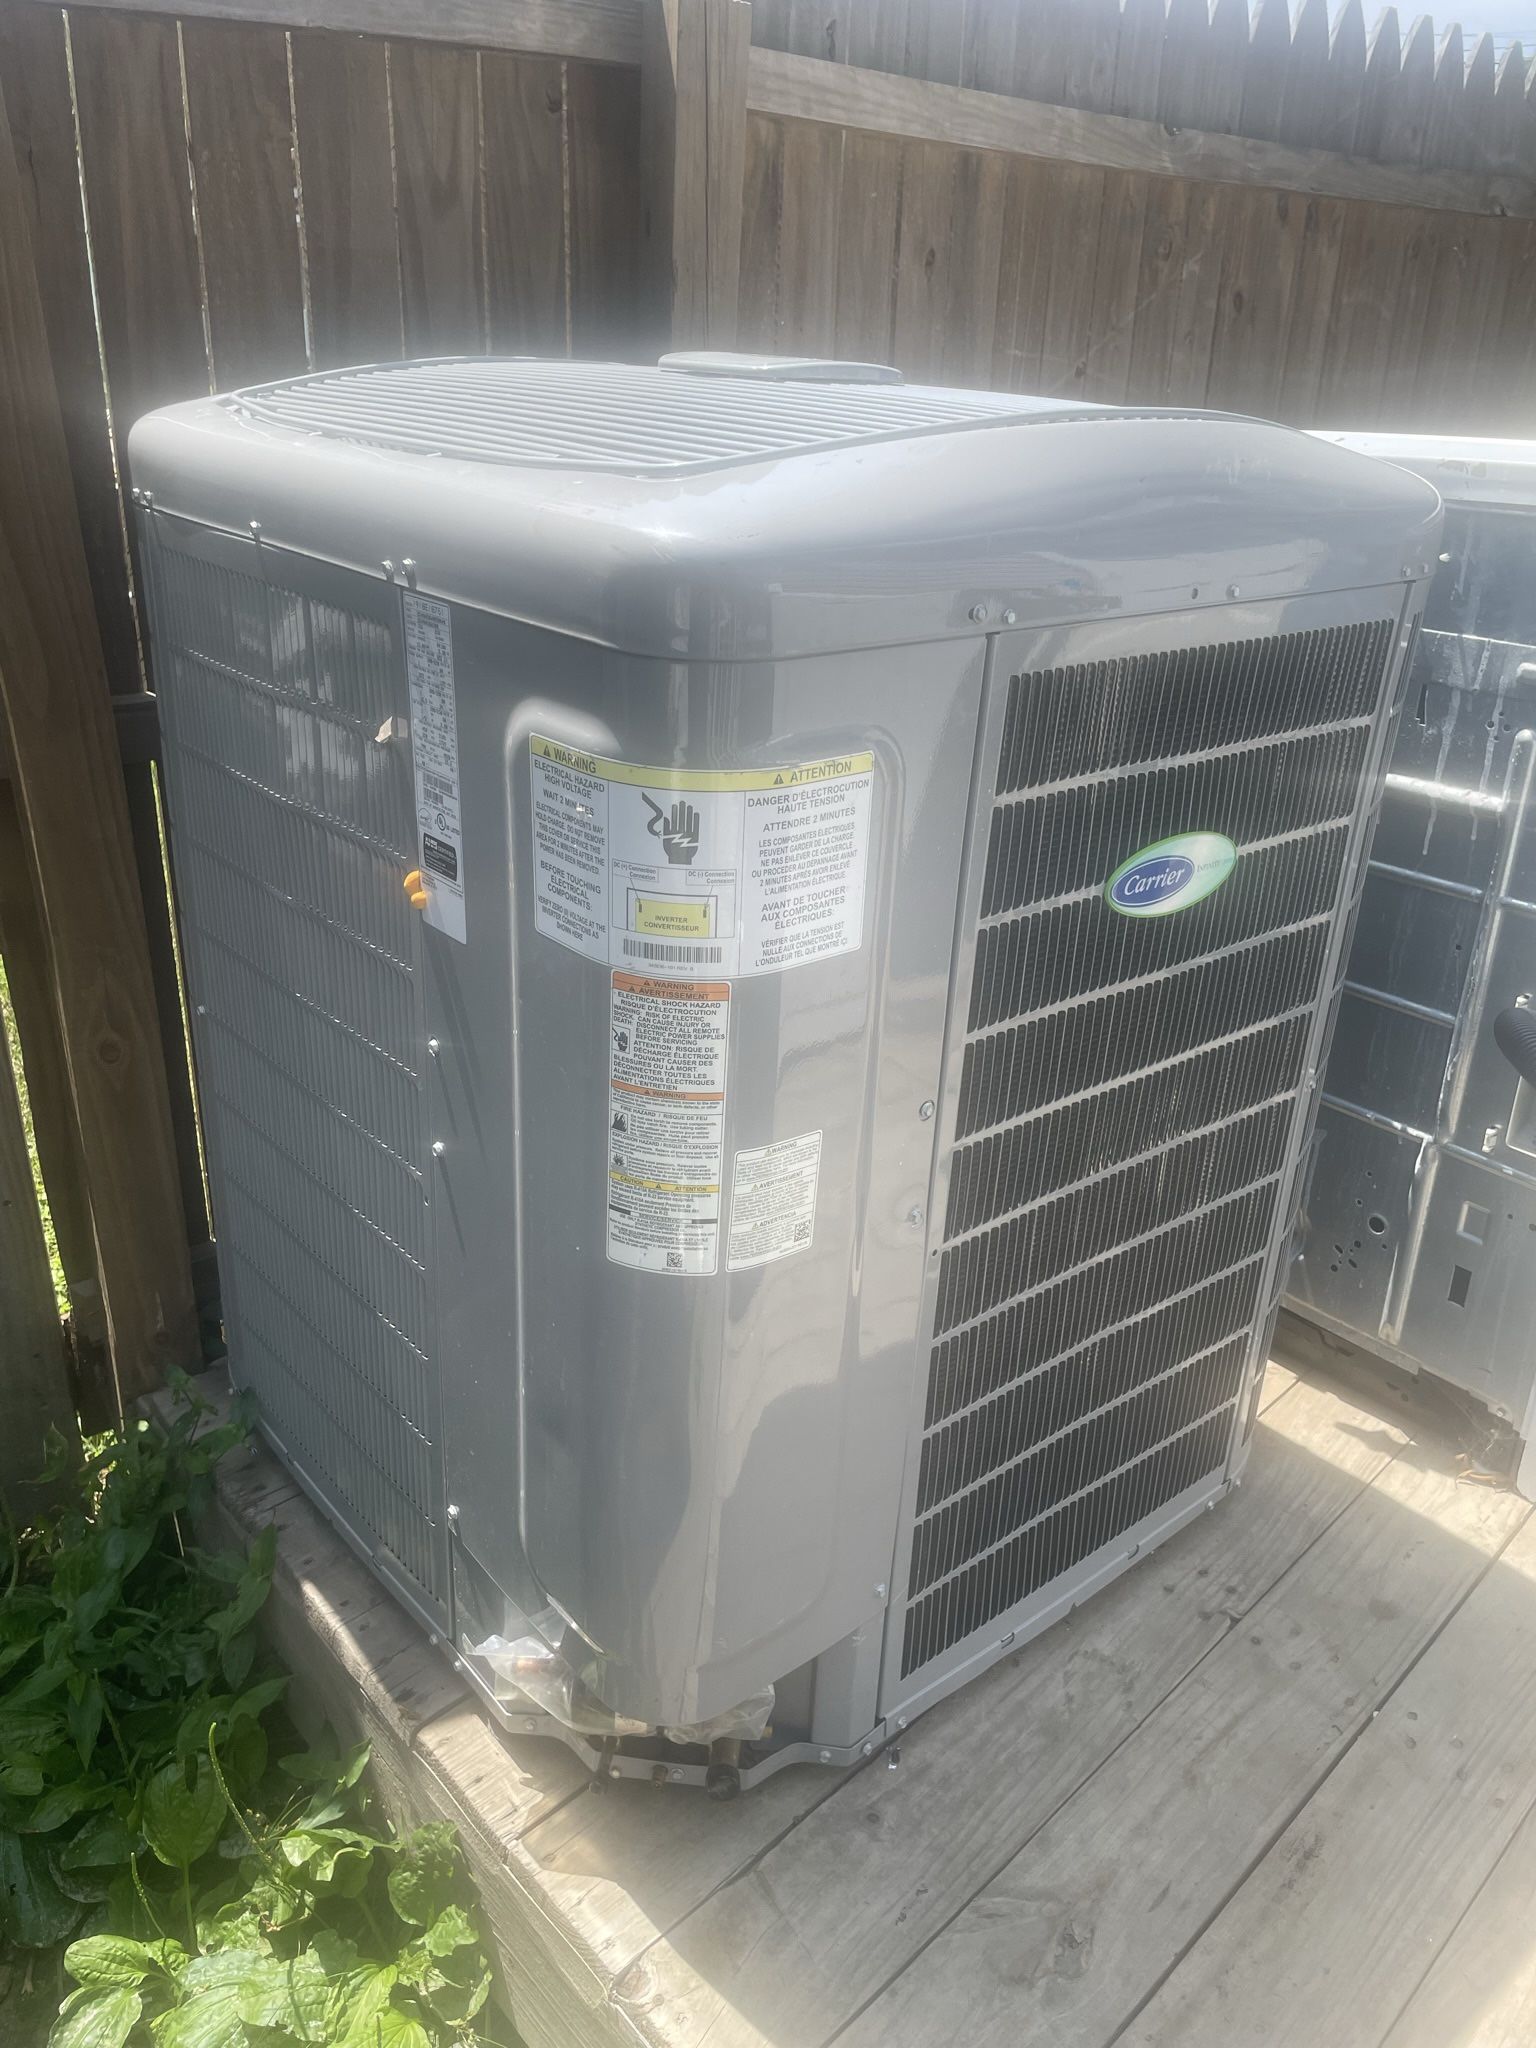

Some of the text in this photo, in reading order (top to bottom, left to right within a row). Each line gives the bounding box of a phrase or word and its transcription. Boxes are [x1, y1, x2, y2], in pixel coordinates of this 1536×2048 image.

[554, 748, 596, 773] WARNING
[535, 760, 604, 792] ELECTRICAL HAZARD
[791, 761, 852, 783] ATTENTION
[545, 774, 591, 799] HIGH VOLTAGE
[748, 779, 869, 807] DANGER D'ÉLECTROCUTION
[543, 788, 558, 800] WAIT
[560, 796, 563, 804] 2
[778, 794, 845, 814] HAUTE TENSION
[763, 807, 855, 832] ATTENDRE 2 MINUTES
[759, 839, 771, 847] LES
[773, 831, 816, 846] COMPOSANTES
[760, 847, 788, 857] PEUVENT
[790, 841, 812, 853] GARDER
[823, 838, 830, 847] LA
[752, 870, 761, 878] OU
[798, 862, 806, 870] AU
[840, 850, 858, 859] AVANT
[761, 859, 770, 867] NE
[771, 857, 783, 866] PAS
[812, 849, 819, 857] CE
[541, 860, 601, 894] BEFORE TOUCHING
[760, 879, 763, 887] 2
[765, 875, 791, 885] MINUTES
[1124, 868, 1185, 895] Carrier
[551, 875, 589, 900] ELECTRICAL
[761, 896, 845, 922] AUX COMPOSANTES
[762, 900, 790, 911] AVANT
[794, 896, 804, 905] DE
[644, 922, 699, 931] CONVERTISSEUR
[655, 915, 688, 923] INVERTER
[789, 933, 800, 941] QUE
[802, 931, 809, 939] LA
[834, 921, 844, 930] EST
[762, 946, 782, 957] NULLE
[794, 949, 804, 957] TEL
[654, 980, 694, 991] WARNING
[618, 992, 659, 1005] ELECTRICAL
[639, 988, 710, 999] AVERTISSEMENT
[621, 1000, 645, 1010] RISQUE
[636, 1028, 666, 1038] ELECTRIC
[637, 1022, 677, 1032] DISCONNECT
[636, 1034, 660, 1042] BEFORE
[614, 1054, 652, 1068] BLESSURES
[634, 1053, 665, 1063] POUVANT
[614, 1068, 664, 1083] ALIMENTATIONS
[664, 1070, 691, 1078] TOUTES
[614, 1074, 677, 1090] AVANT L'ENTRETIEN
[653, 1090, 686, 1098] WARNING
[772, 1141, 797, 1153] WARNING
